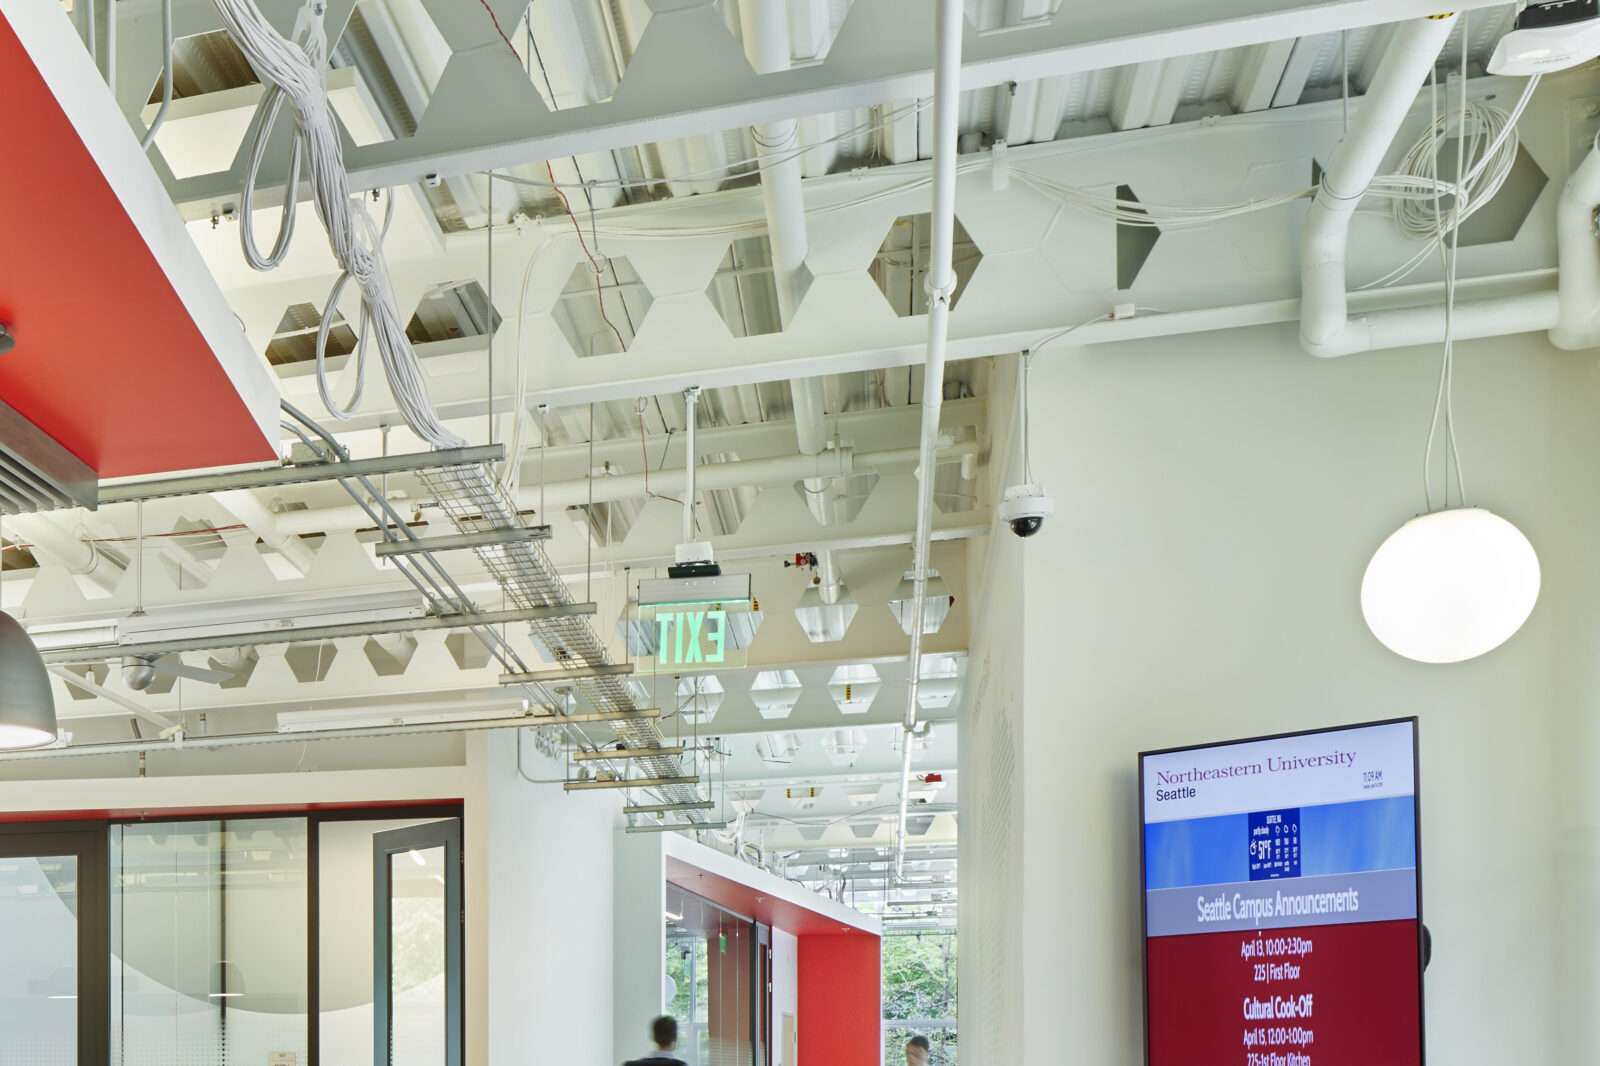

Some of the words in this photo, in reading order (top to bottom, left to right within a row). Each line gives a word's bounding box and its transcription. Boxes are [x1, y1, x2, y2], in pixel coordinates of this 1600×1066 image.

[1156, 763, 1262, 786] Northeastern
[1267, 751, 1357, 773] University
[1156, 786, 1197, 802] Seattle
[1197, 892, 1232, 923] Seattle
[1233, 892, 1273, 926] Campus
[1274, 887, 1359, 917] Announcements
[1241, 938, 1256, 962] April
[1265, 936, 1313, 959] 10:00-2:30pm
[1253, 963, 1266, 982] 225
[1269, 963, 1284, 981] First
[1284, 961, 1301, 980] Floor
[1243, 995, 1275, 1020] Cultural
[1275, 993, 1313, 1019] Cook-Off
[1243, 1027, 1258, 1050] April
[1258, 1027, 1267, 1047] 15,
[1267, 1026, 1314, 1049] 12:00-1:00pm
